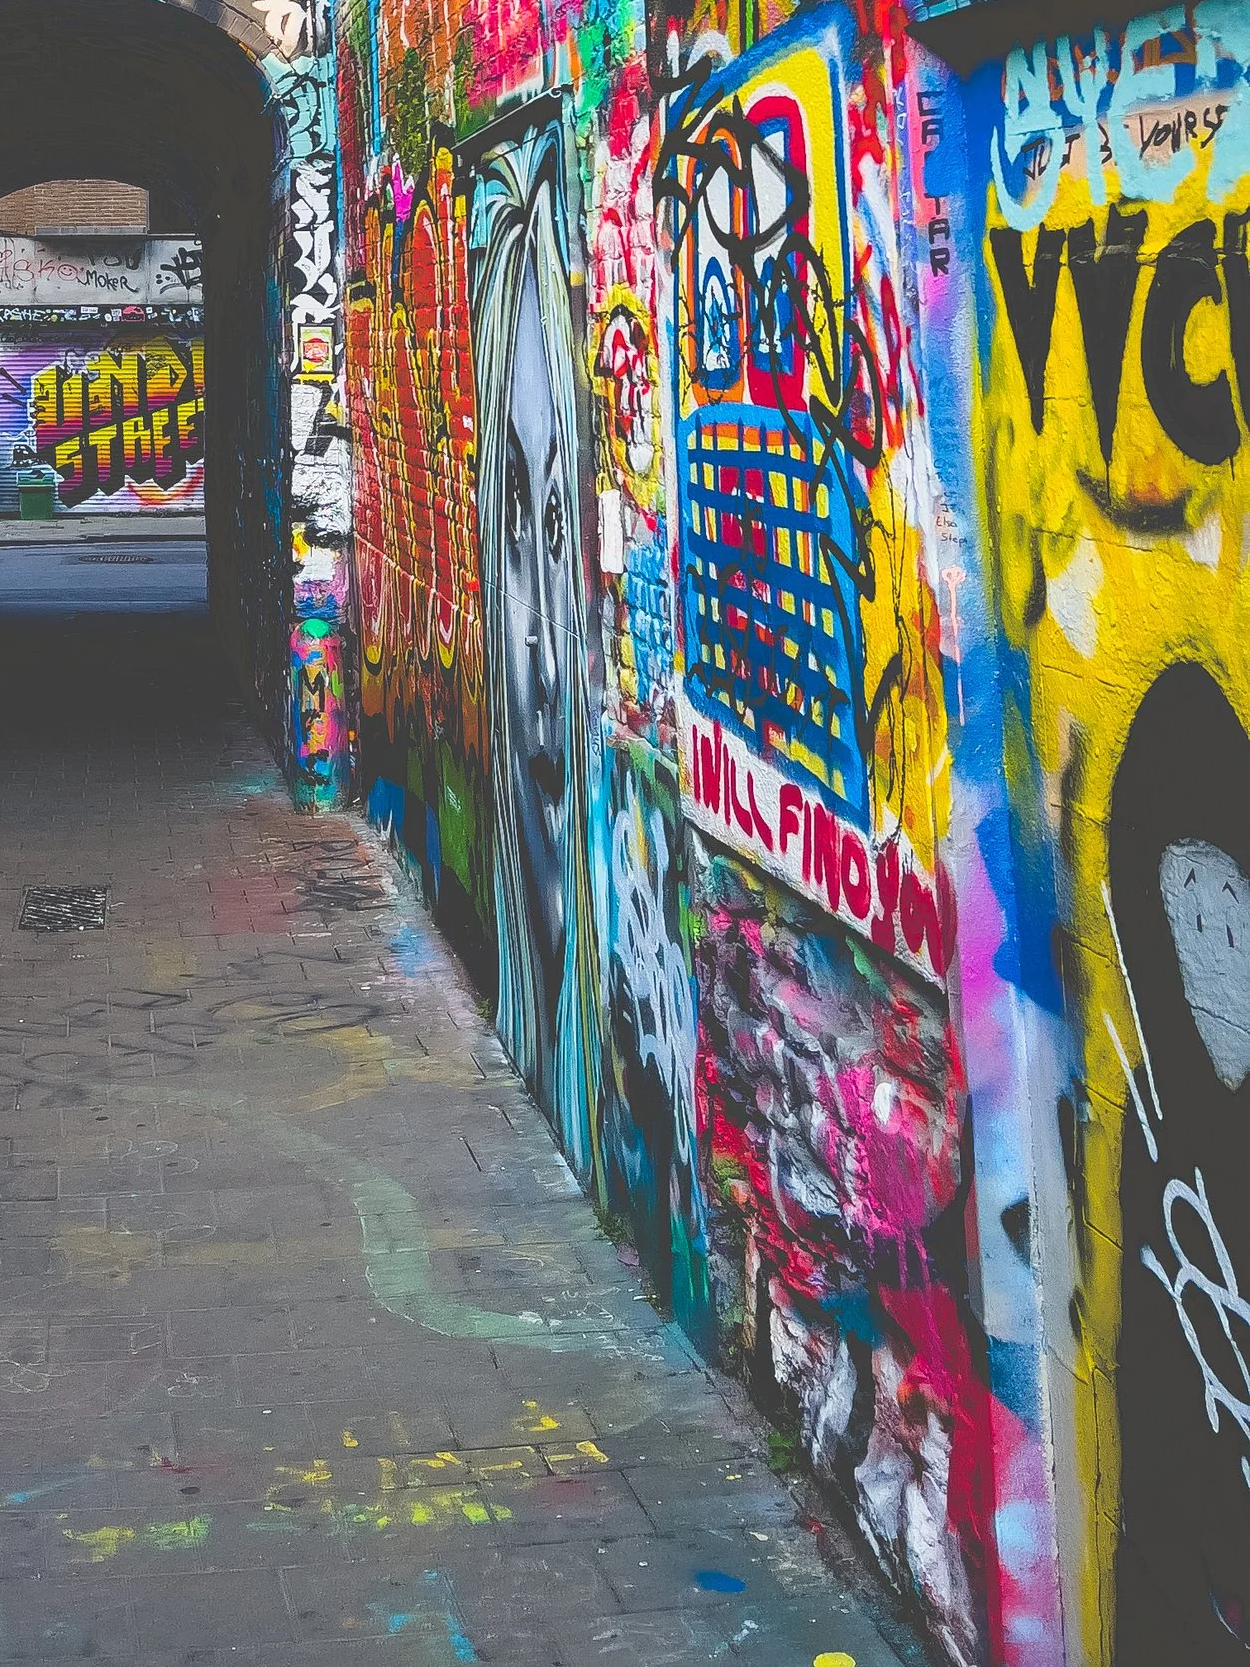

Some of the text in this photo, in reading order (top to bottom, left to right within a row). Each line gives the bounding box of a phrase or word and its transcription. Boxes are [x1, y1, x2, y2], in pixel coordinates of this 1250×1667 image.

[700, 720, 774, 852] WILL
[779, 783, 871, 921] FIND
[870, 838, 959, 977] YOU
